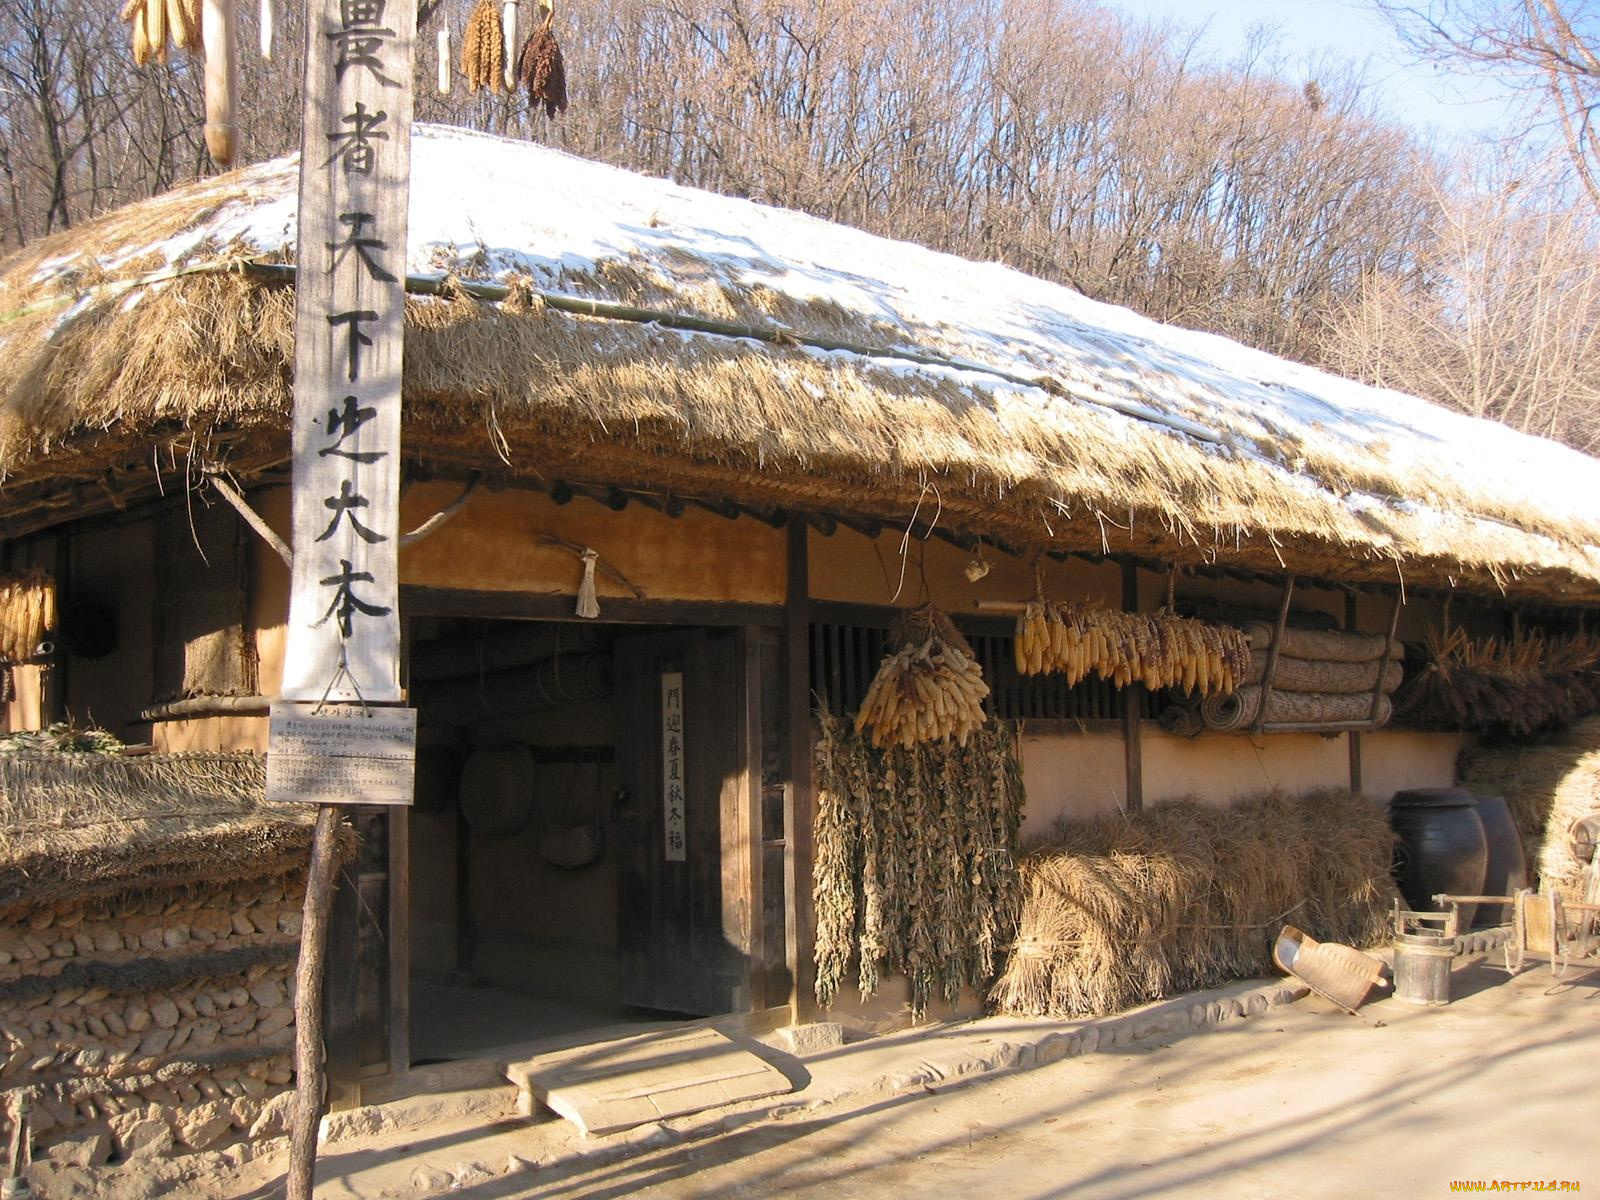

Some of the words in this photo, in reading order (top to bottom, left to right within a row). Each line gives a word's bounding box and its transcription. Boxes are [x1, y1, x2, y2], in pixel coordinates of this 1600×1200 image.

[666, 687, 682, 851] 門迎春夏秋冬福
